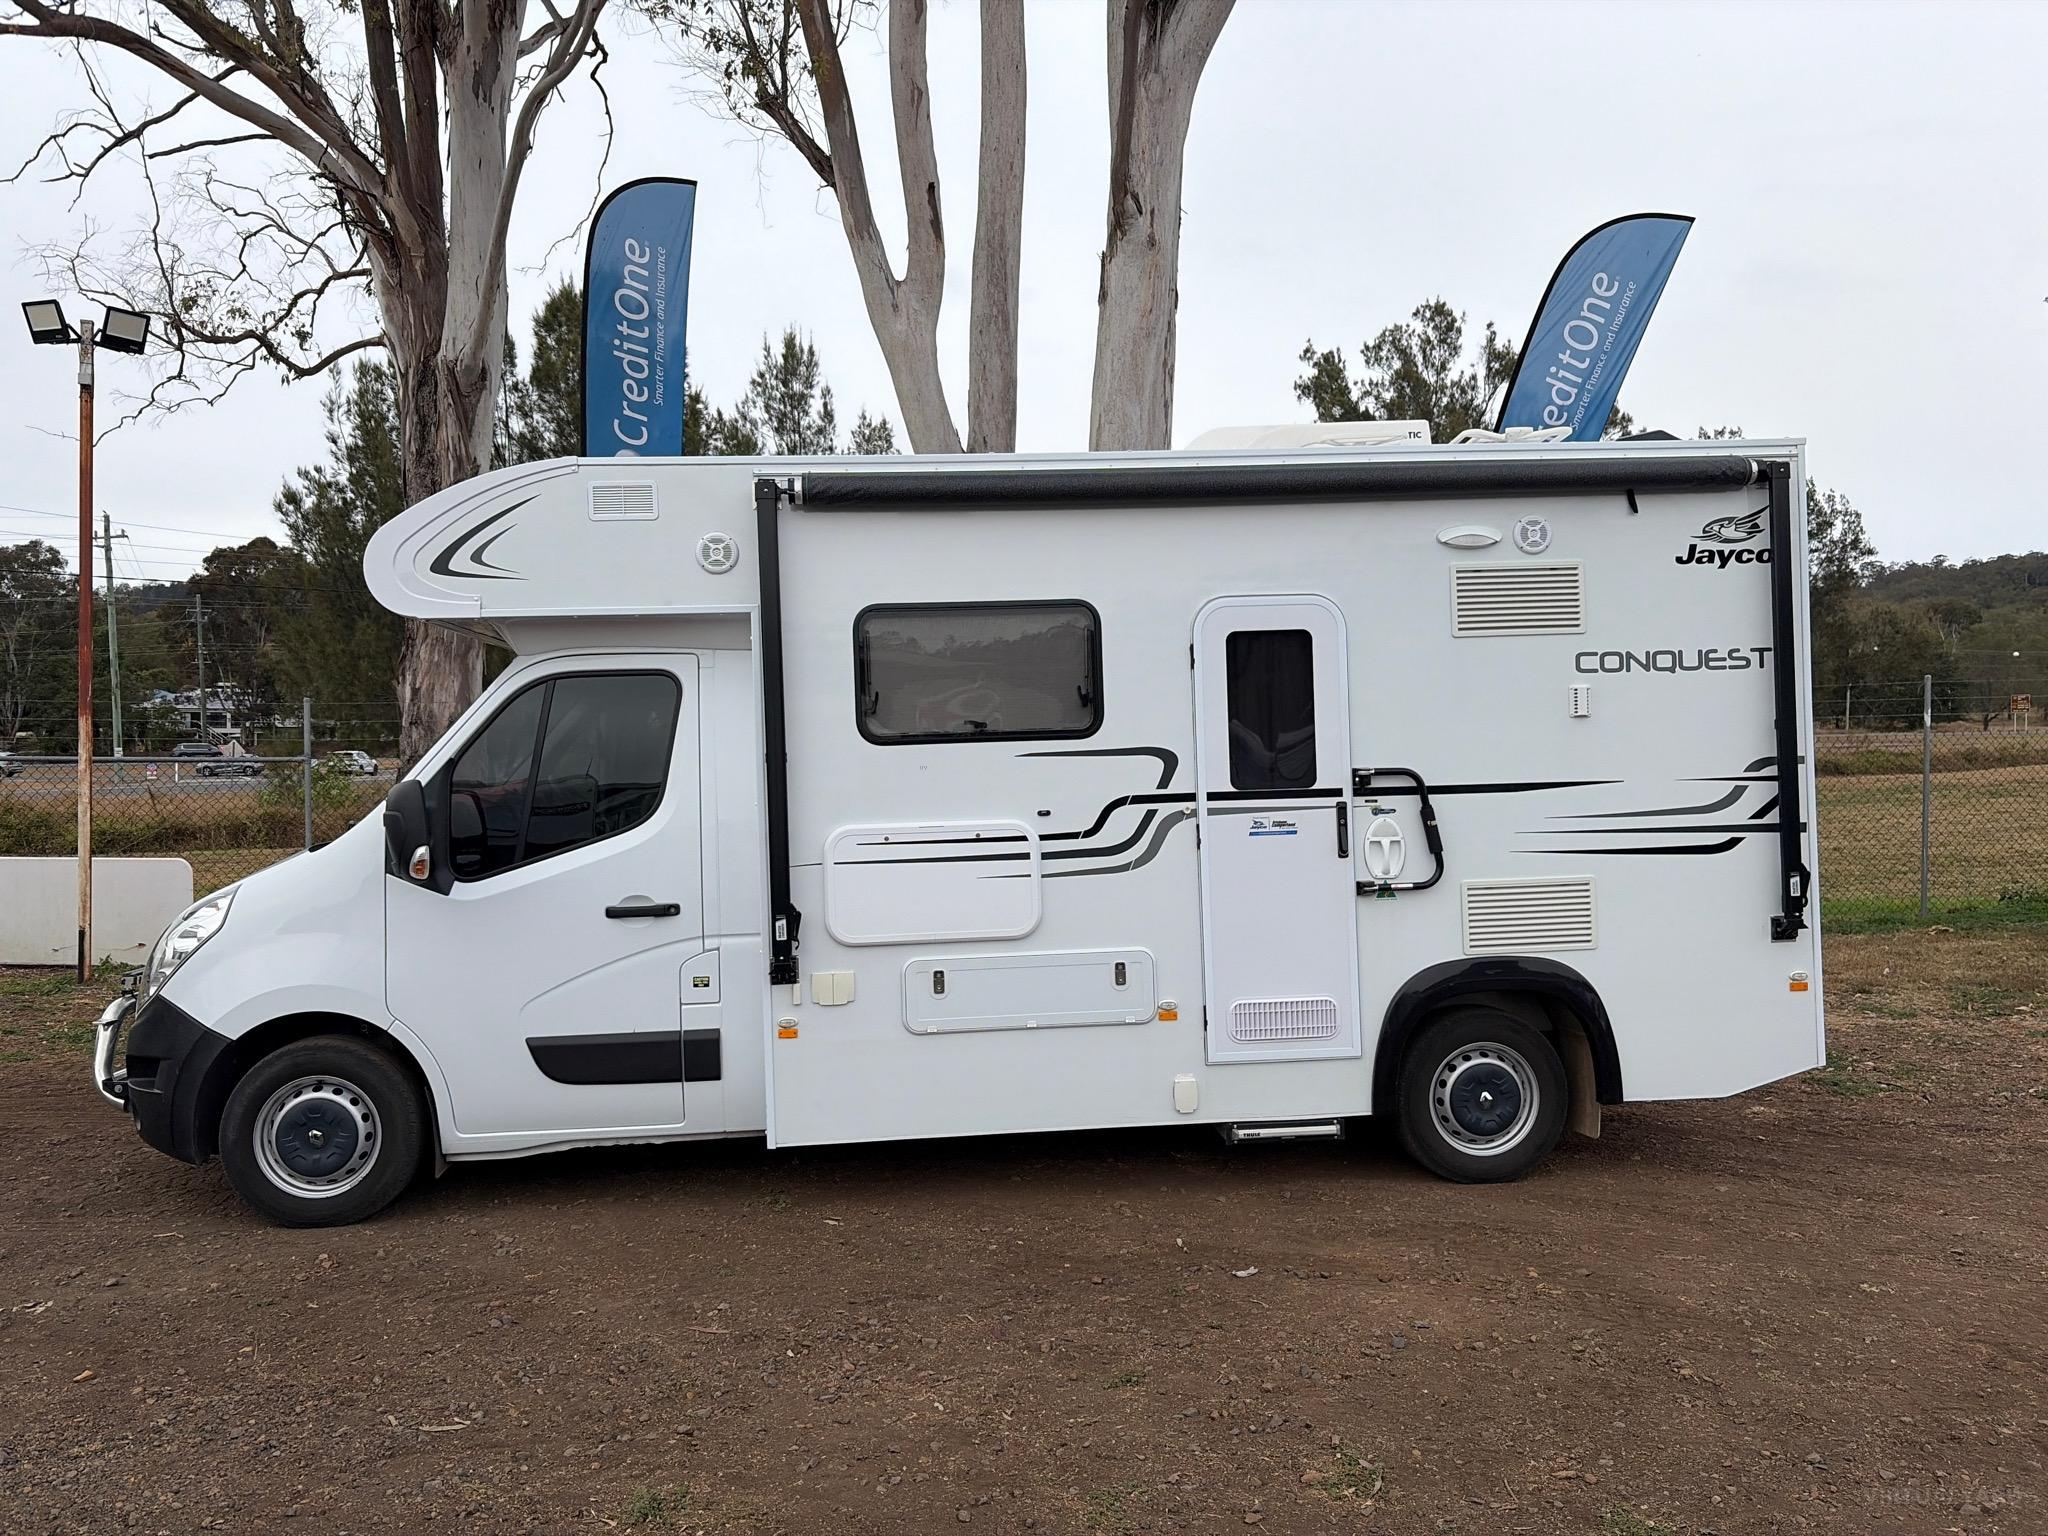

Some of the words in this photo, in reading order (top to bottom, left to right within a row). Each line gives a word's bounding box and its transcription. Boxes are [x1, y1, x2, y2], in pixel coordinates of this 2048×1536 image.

[656, 246, 666, 298] Insurance
[656, 299, 665, 320] and
[1609, 281, 1637, 332] Insurance
[613, 238, 650, 446] CreditOne
[654, 322, 665, 362] Finance
[1538, 272, 1619, 430] editOne
[1603, 333, 1616, 352] and
[654, 364, 665, 406] Smarter
[1585, 354, 1608, 390] Finance
[1570, 391, 1591, 430] Smarter
[1675, 543, 1771, 569] Jayco
[1575, 647, 1772, 674] CONQUEST
